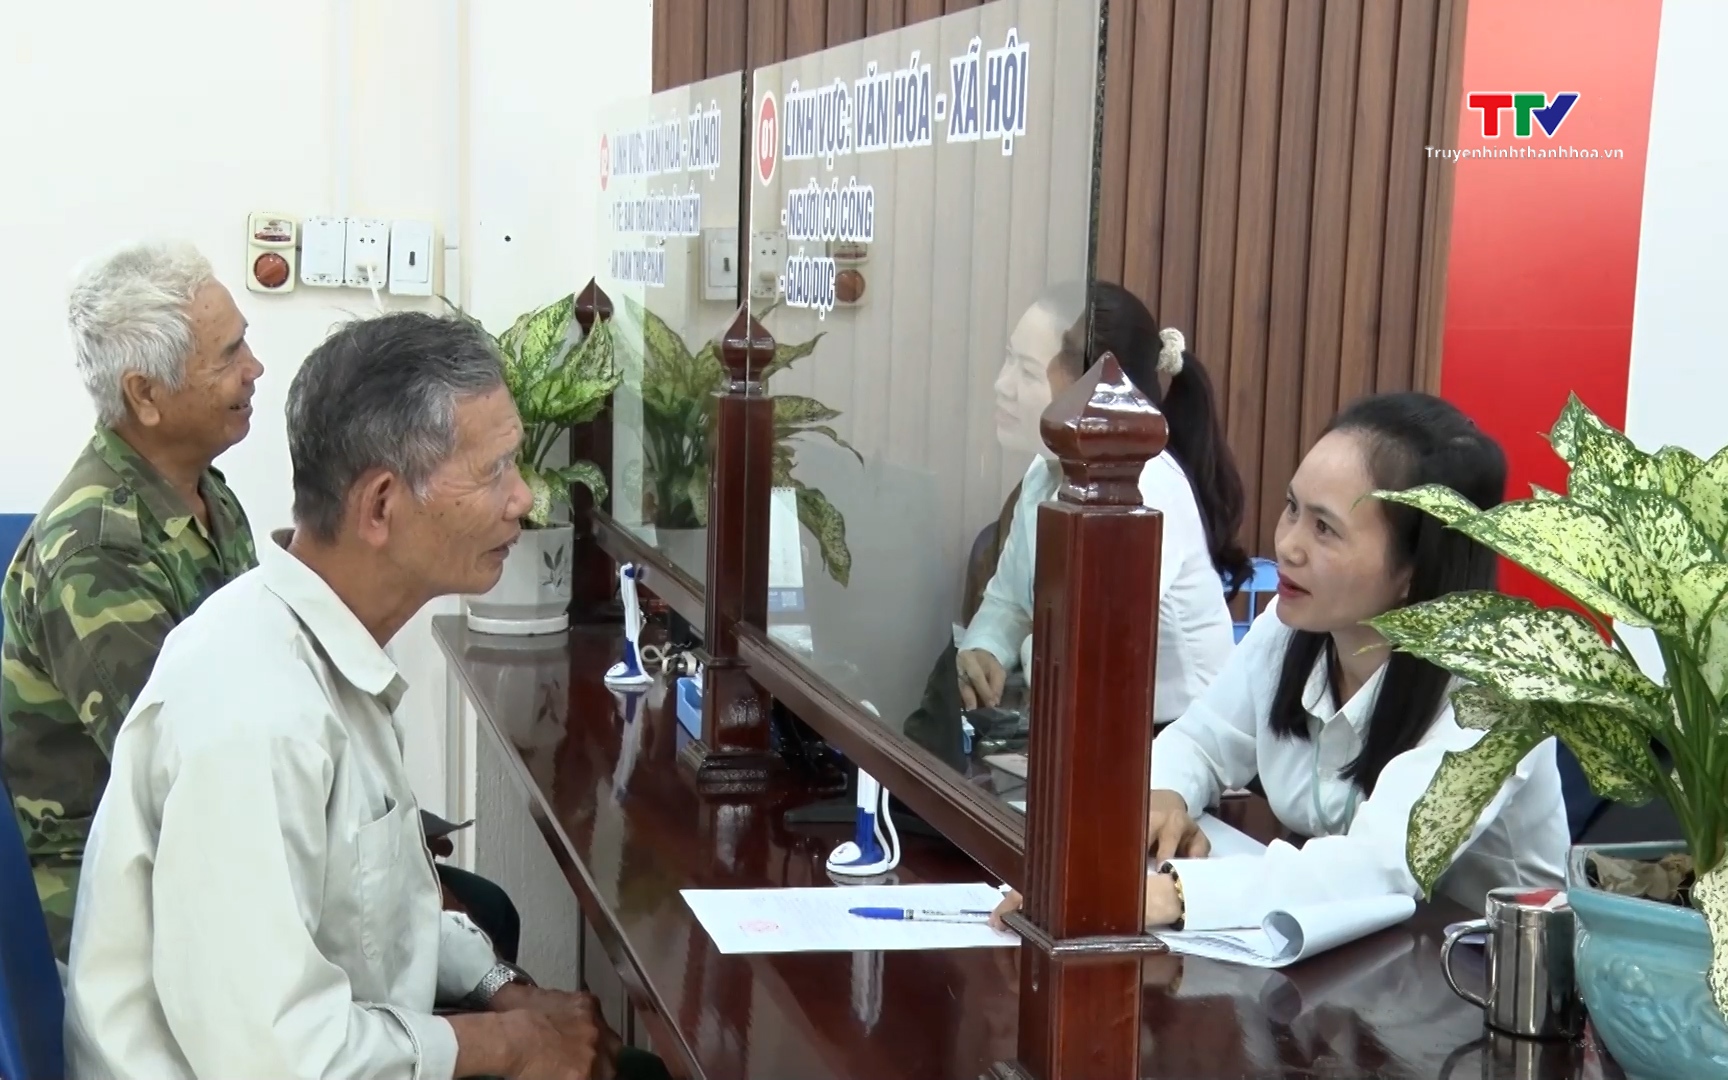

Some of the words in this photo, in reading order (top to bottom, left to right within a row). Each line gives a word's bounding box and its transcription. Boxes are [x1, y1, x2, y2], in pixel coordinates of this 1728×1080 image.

[784, 83, 815, 158] LĨNH
[818, 80, 851, 166] VỰC:
[855, 66, 889, 149] VĂN
[893, 56, 930, 144] HÓA
[949, 41, 979, 136] XÃ
[985, 34, 1028, 151] HỘI
[688, 106, 701, 167] XÃ
[703, 102, 720, 177] HỘI
[760, 118, 774, 162] 01
[823, 180, 838, 237] CÓ
[841, 178, 873, 238] CÔNG
[786, 250, 810, 304] GIÁO
[813, 260, 835, 317] DỤC
